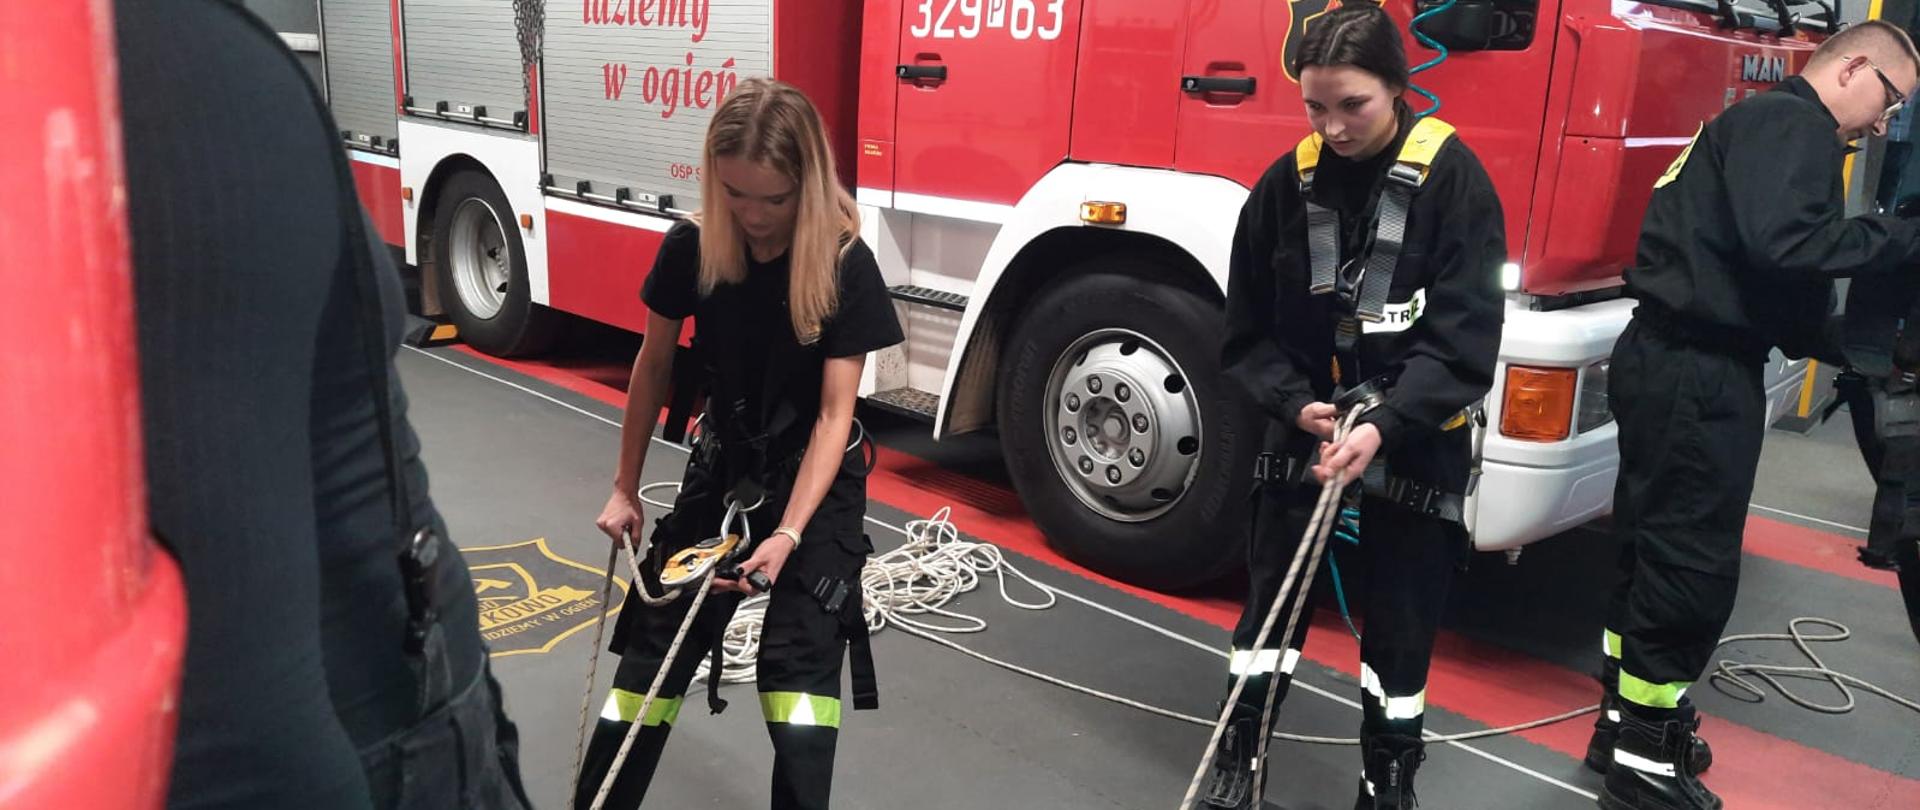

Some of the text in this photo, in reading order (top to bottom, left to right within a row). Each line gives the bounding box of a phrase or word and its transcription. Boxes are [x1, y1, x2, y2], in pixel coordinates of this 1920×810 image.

[1742, 54, 1784, 82] MAN
[602, 51, 737, 118] w ogień
[671, 163, 693, 180] OSP
[481, 619, 542, 641] IDZIEMY
[541, 611, 560, 622] W
